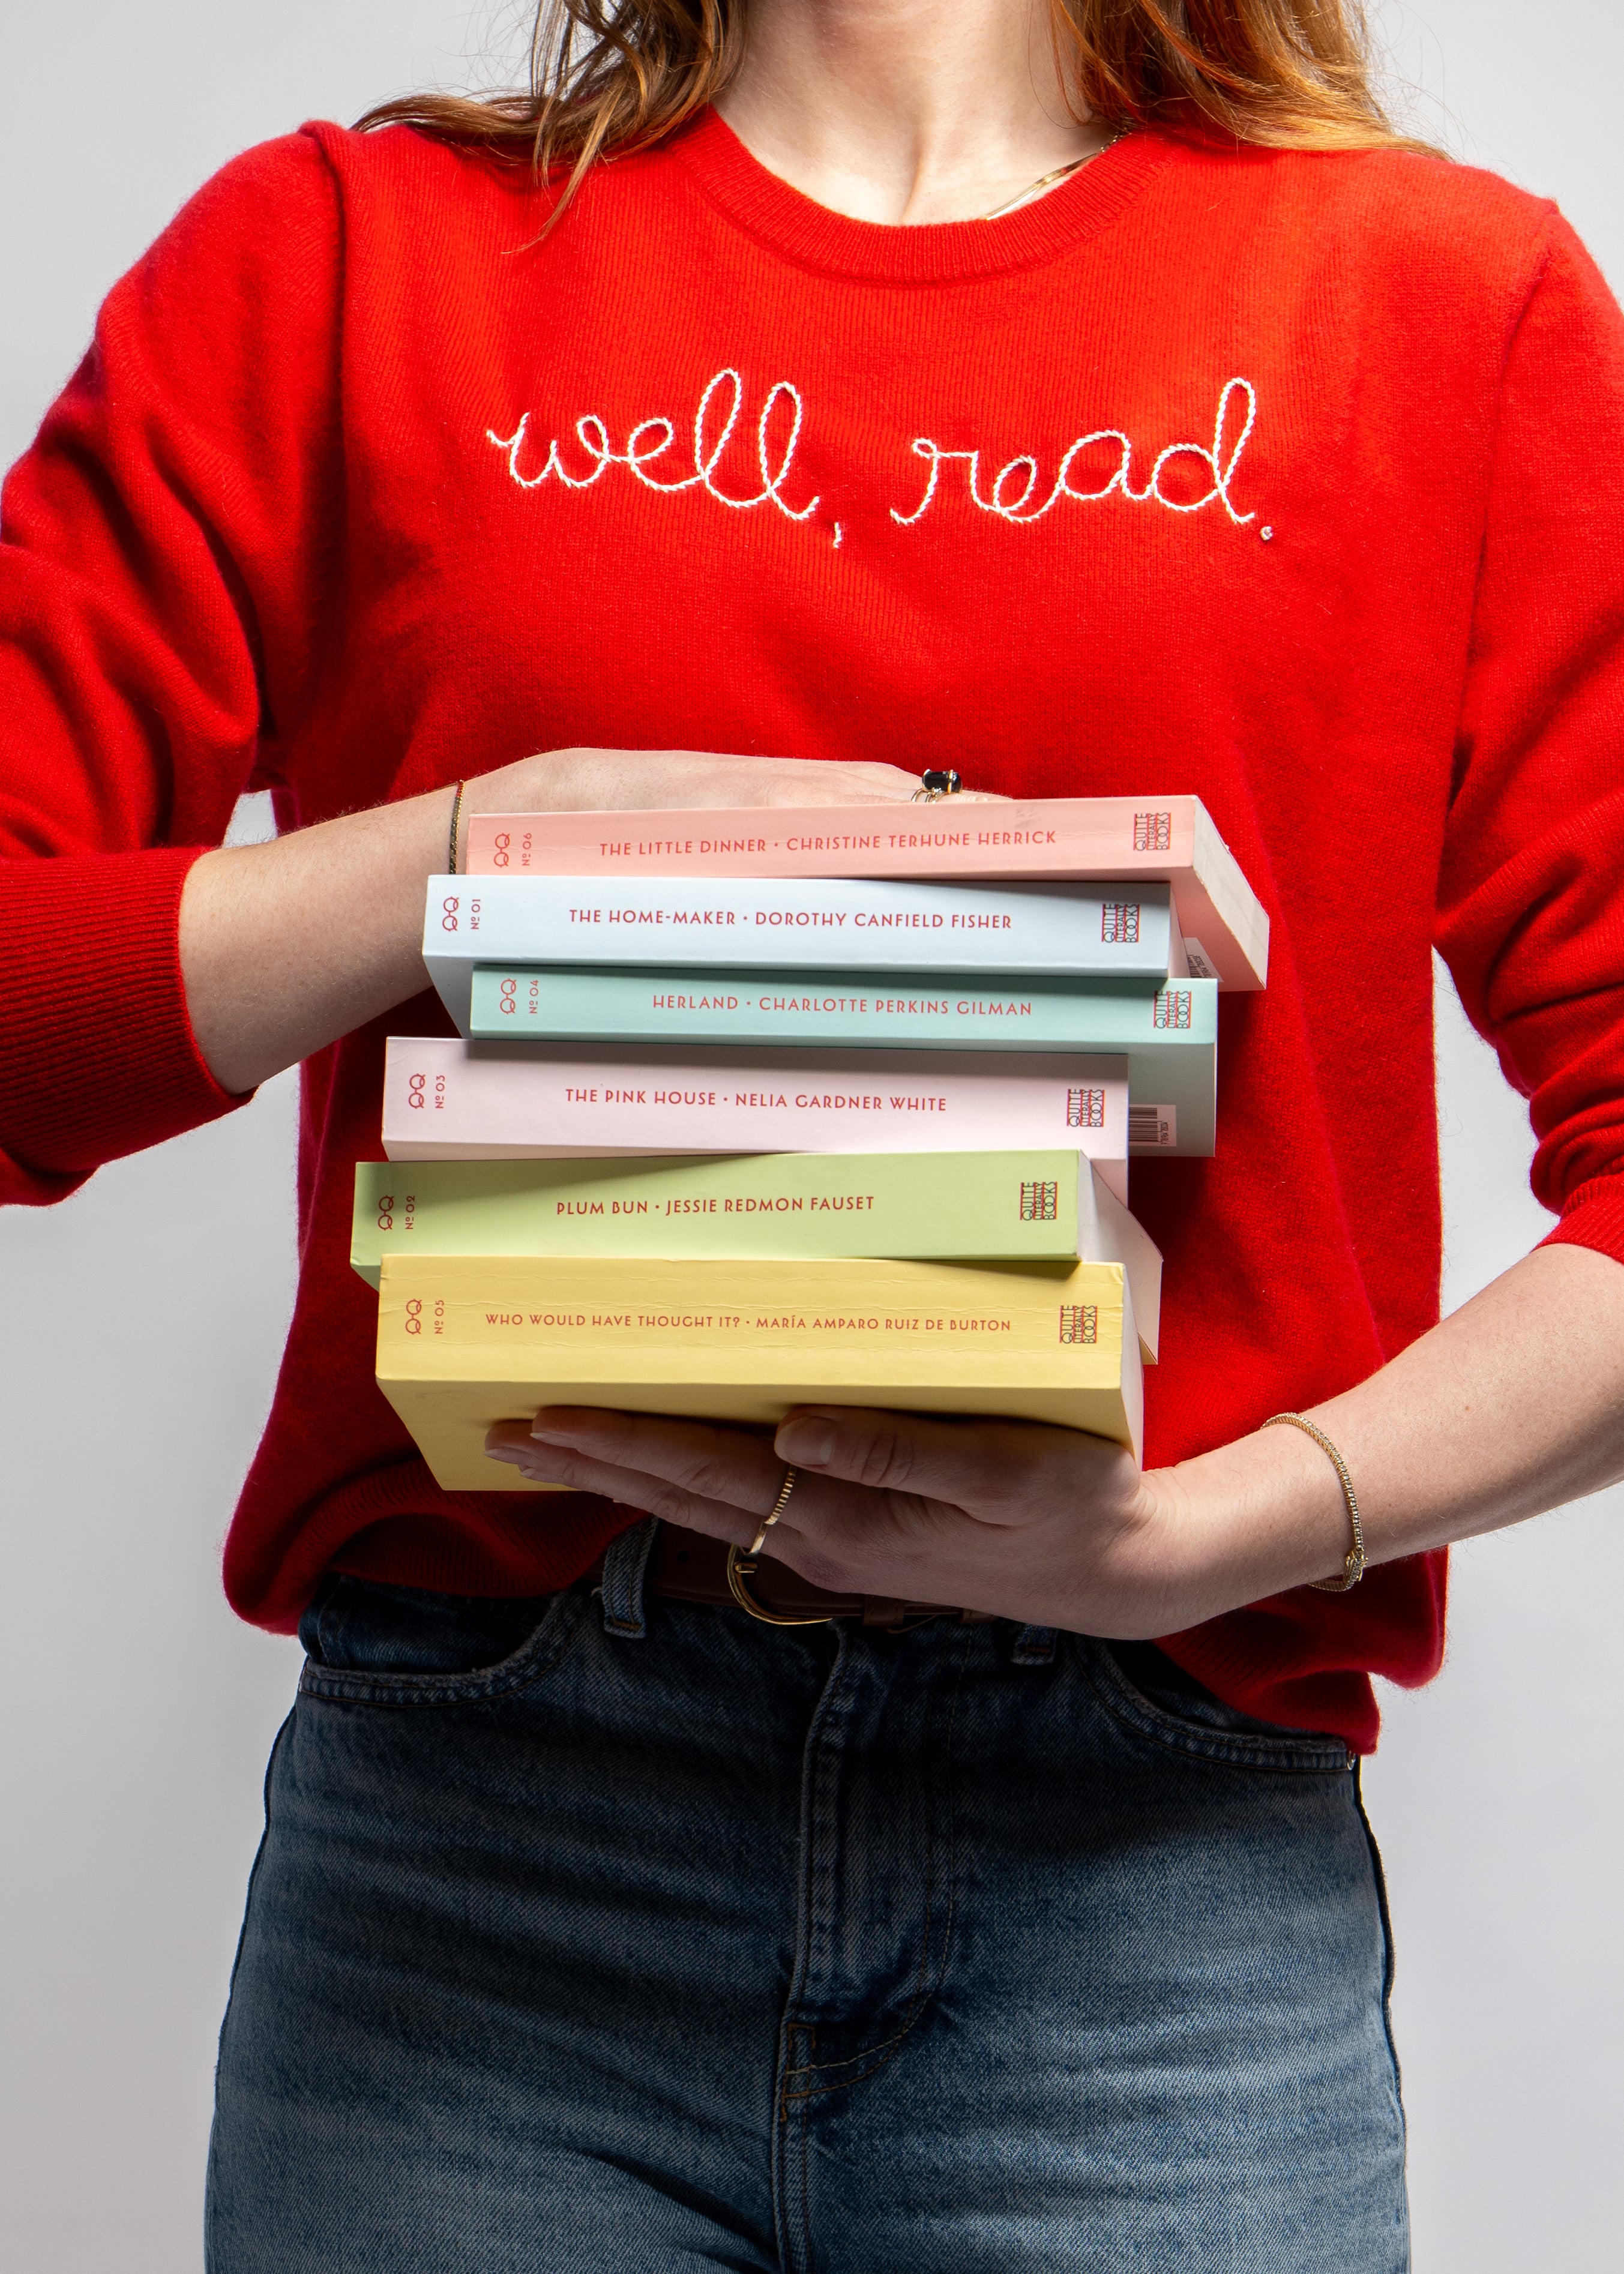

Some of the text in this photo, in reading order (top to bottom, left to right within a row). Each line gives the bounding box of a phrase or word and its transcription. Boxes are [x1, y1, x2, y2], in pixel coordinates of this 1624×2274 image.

[486, 367, 1273, 549] well, read.
[599, 830, 1056, 856] THE LITTLE DINNER CHRISTINE TERHUNE HERRICK
[1135, 813, 1147, 851] QUITE
[1147, 813, 1156, 850] LITERALLY
[1156, 812, 1168, 850] BOOKS
[570, 909, 1011, 929] THE HOME-MAKER DOROTHY CANFIELD FISHER
[1104, 904, 1116, 943] QUITE
[1116, 904, 1125, 942] LITERALLY
[1124, 904, 1137, 942] BOOKS
[652, 994, 1032, 1015] HERLAND CHARLOTTE PERKINS GILMAN
[1155, 990, 1167, 1029] QUITE
[1167, 990, 1176, 1028] LITERALLY
[1176, 990, 1189, 1029] BOOKS
[565, 1088, 946, 1111] THE PINK HOUSE NELIA GARDNER WHITE
[1069, 1089, 1081, 1127] QUITE
[1081, 1089, 1090, 1126] LITERALLY
[1089, 1089, 1103, 1127] BOOKS
[556, 1196, 874, 1217] PLUM BUN JESSIE REDMON FAUSET
[1022, 1182, 1033, 1221] QUITE
[1033, 1182, 1042, 1220] LITERALLY
[1042, 1182, 1054, 1220] BOOKS
[485, 1313, 1011, 1332] WHO WOULD HAVE THOUGHT IT? MARÍA AMPARO RUIZ DE BURTON
[1062, 1305, 1074, 1344] QUITE
[1073, 1305, 1083, 1343] LITERALLY
[1082, 1305, 1095, 1343] BOOKS
